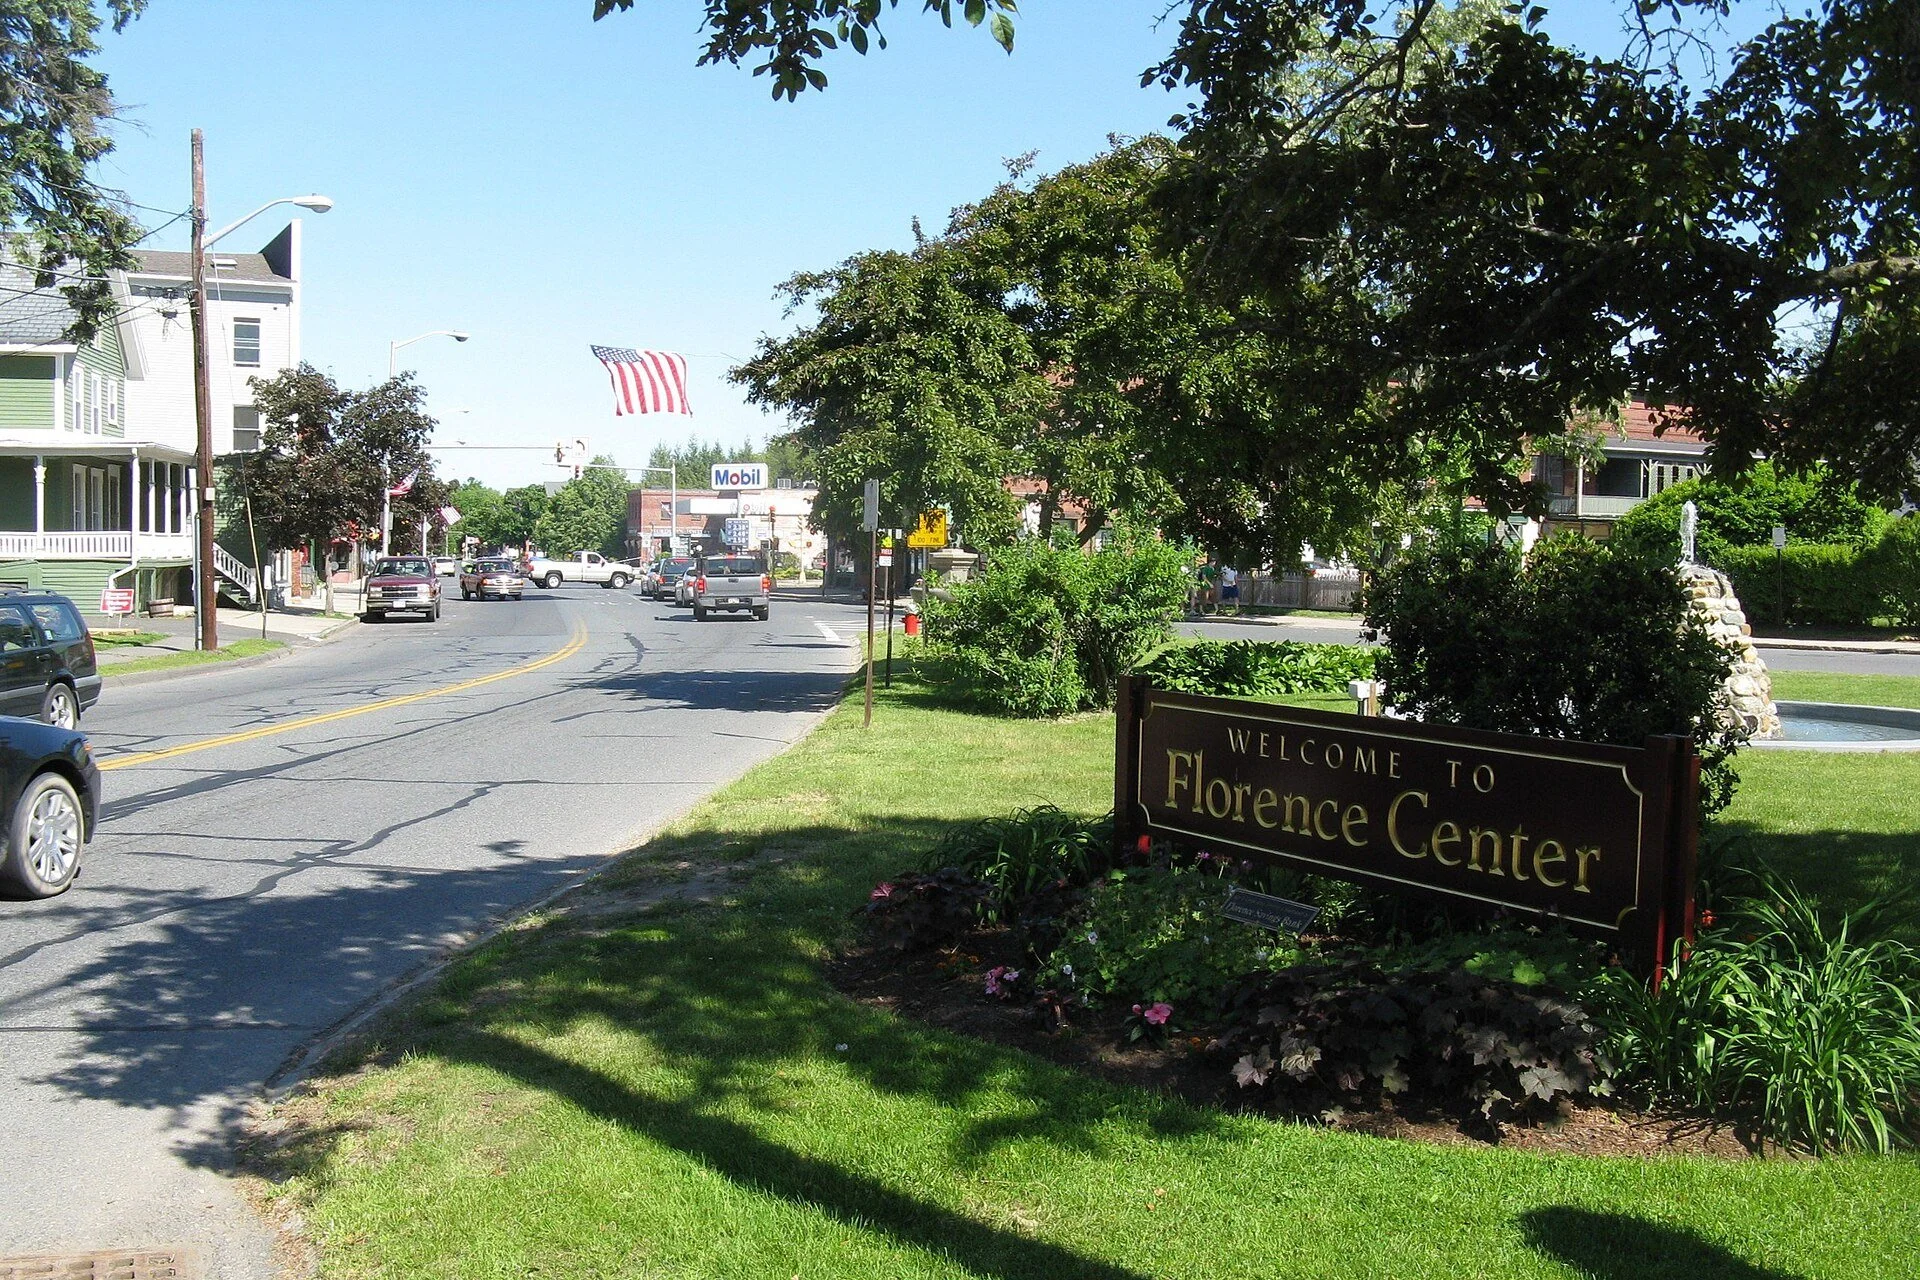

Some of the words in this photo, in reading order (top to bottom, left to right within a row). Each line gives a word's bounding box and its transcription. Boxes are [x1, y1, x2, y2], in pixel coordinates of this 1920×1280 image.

[714, 468, 761, 486] Mobil
[1226, 727, 1402, 780] WELCOME
[1446, 759, 1496, 794] TO
[1164, 747, 1370, 848] Florence
[1386, 788, 1602, 894] Center
[1281, 915, 1303, 929] Bank
